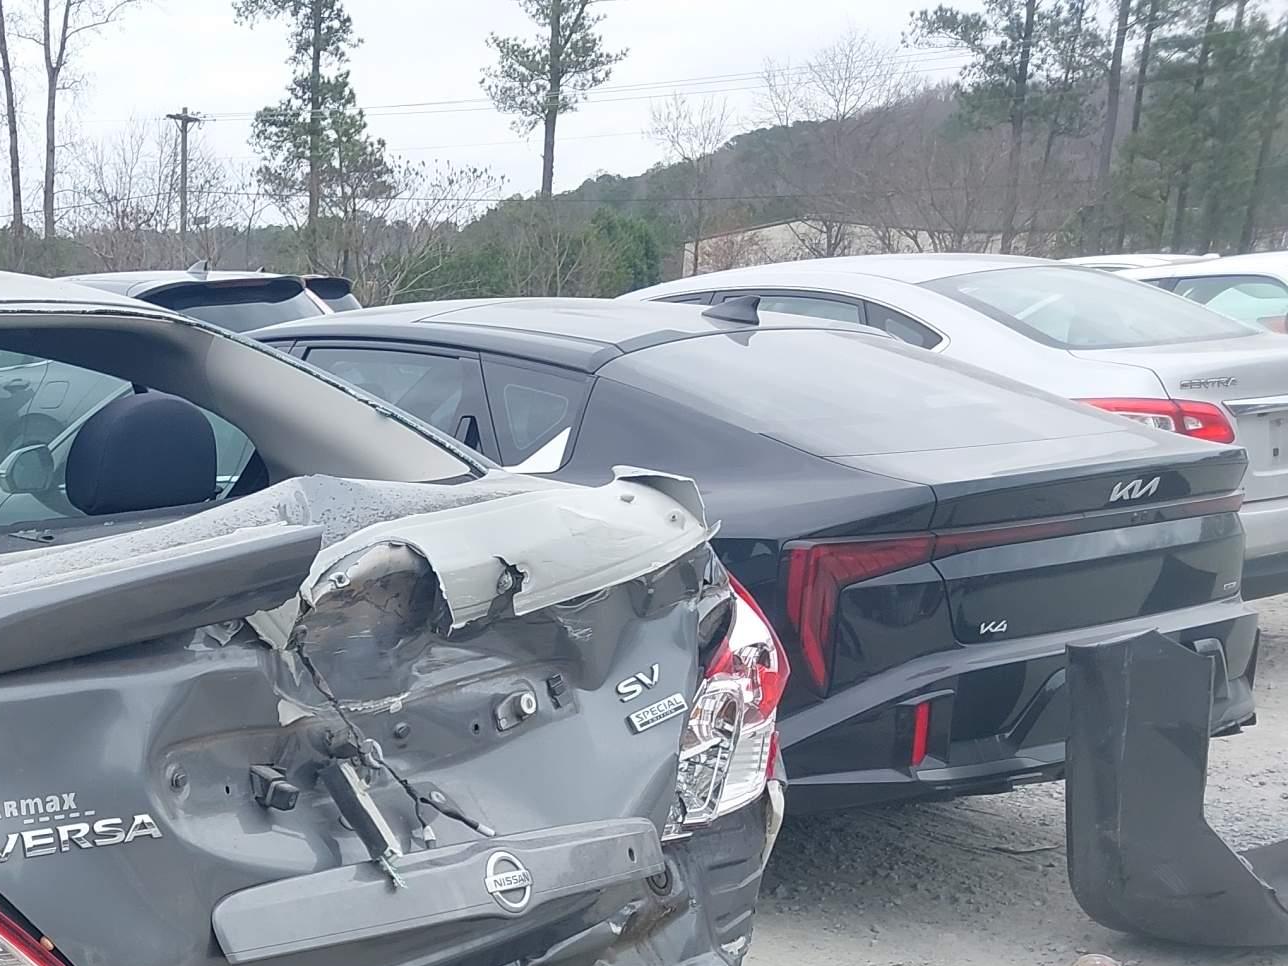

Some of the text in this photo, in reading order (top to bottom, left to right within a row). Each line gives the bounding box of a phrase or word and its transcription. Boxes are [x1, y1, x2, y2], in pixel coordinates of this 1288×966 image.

[979, 619, 1008, 635] K4
[616, 663, 660, 702] SV
[634, 697, 683, 723] SPECIAL
[493, 871, 530, 889] NISSAN
